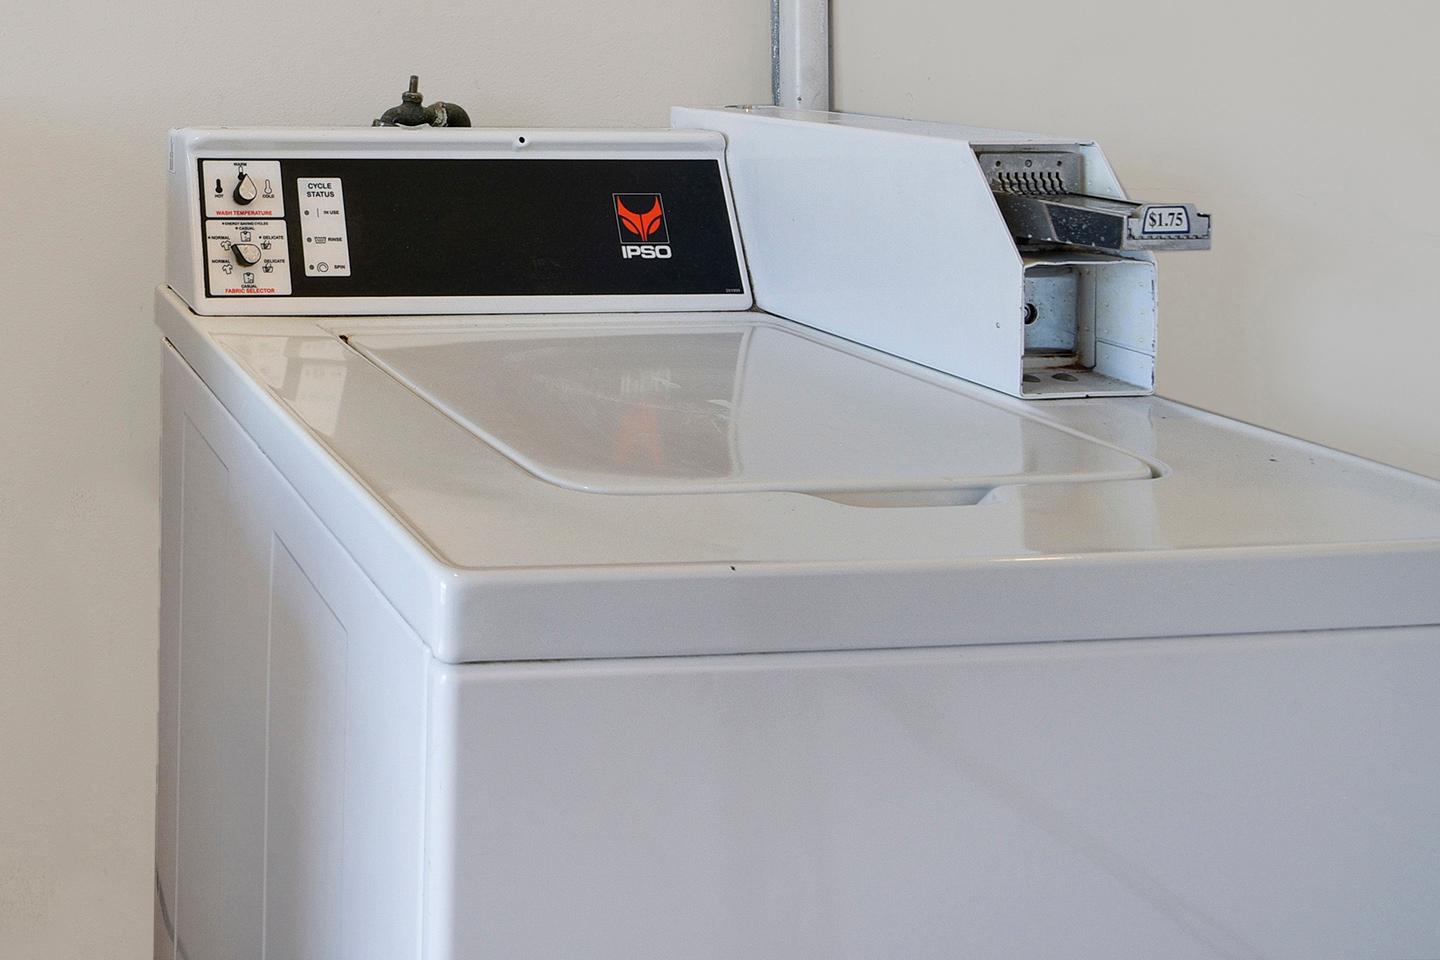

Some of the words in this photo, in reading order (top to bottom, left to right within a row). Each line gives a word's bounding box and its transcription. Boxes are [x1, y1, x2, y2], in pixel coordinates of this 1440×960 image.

[307, 182, 332, 190] CYCLE
[1148, 211, 1183, 228] $1.75
[621, 245, 672, 259] IPSO
